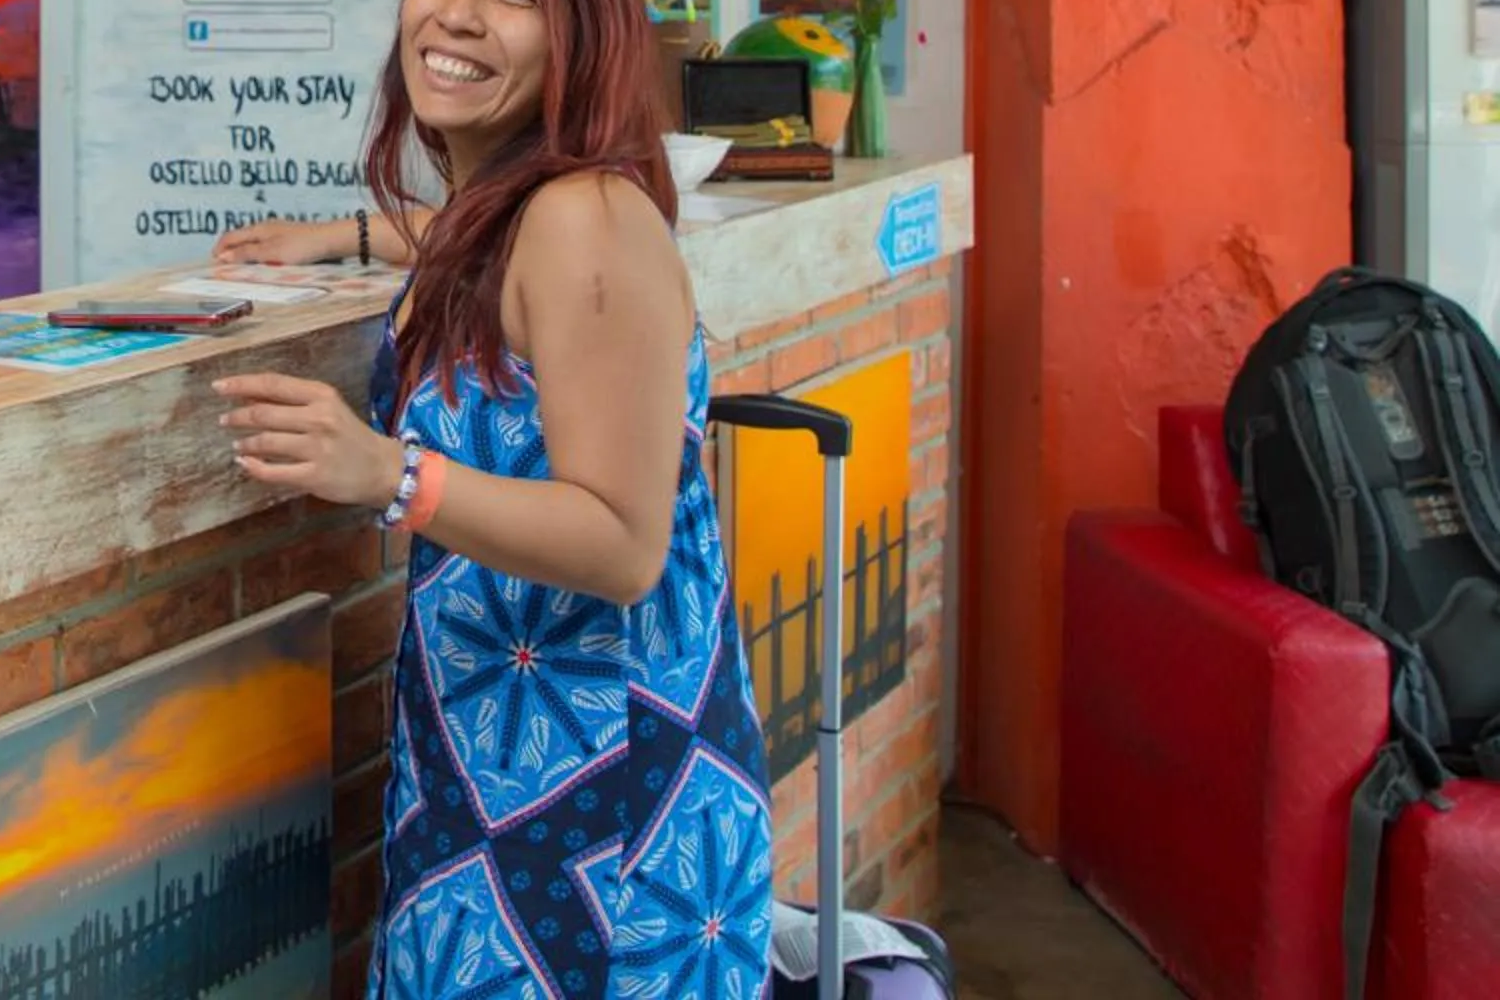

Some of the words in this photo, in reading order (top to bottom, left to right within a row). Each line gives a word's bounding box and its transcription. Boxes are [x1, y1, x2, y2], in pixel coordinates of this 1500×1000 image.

[149, 74, 215, 102] BOOK
[230, 75, 290, 115] YOUR
[296, 74, 355, 120] STAY
[150, 159, 232, 186] OSTELLO
[240, 159, 297, 187] BELLO
[136, 208, 218, 235] OSTELLO
